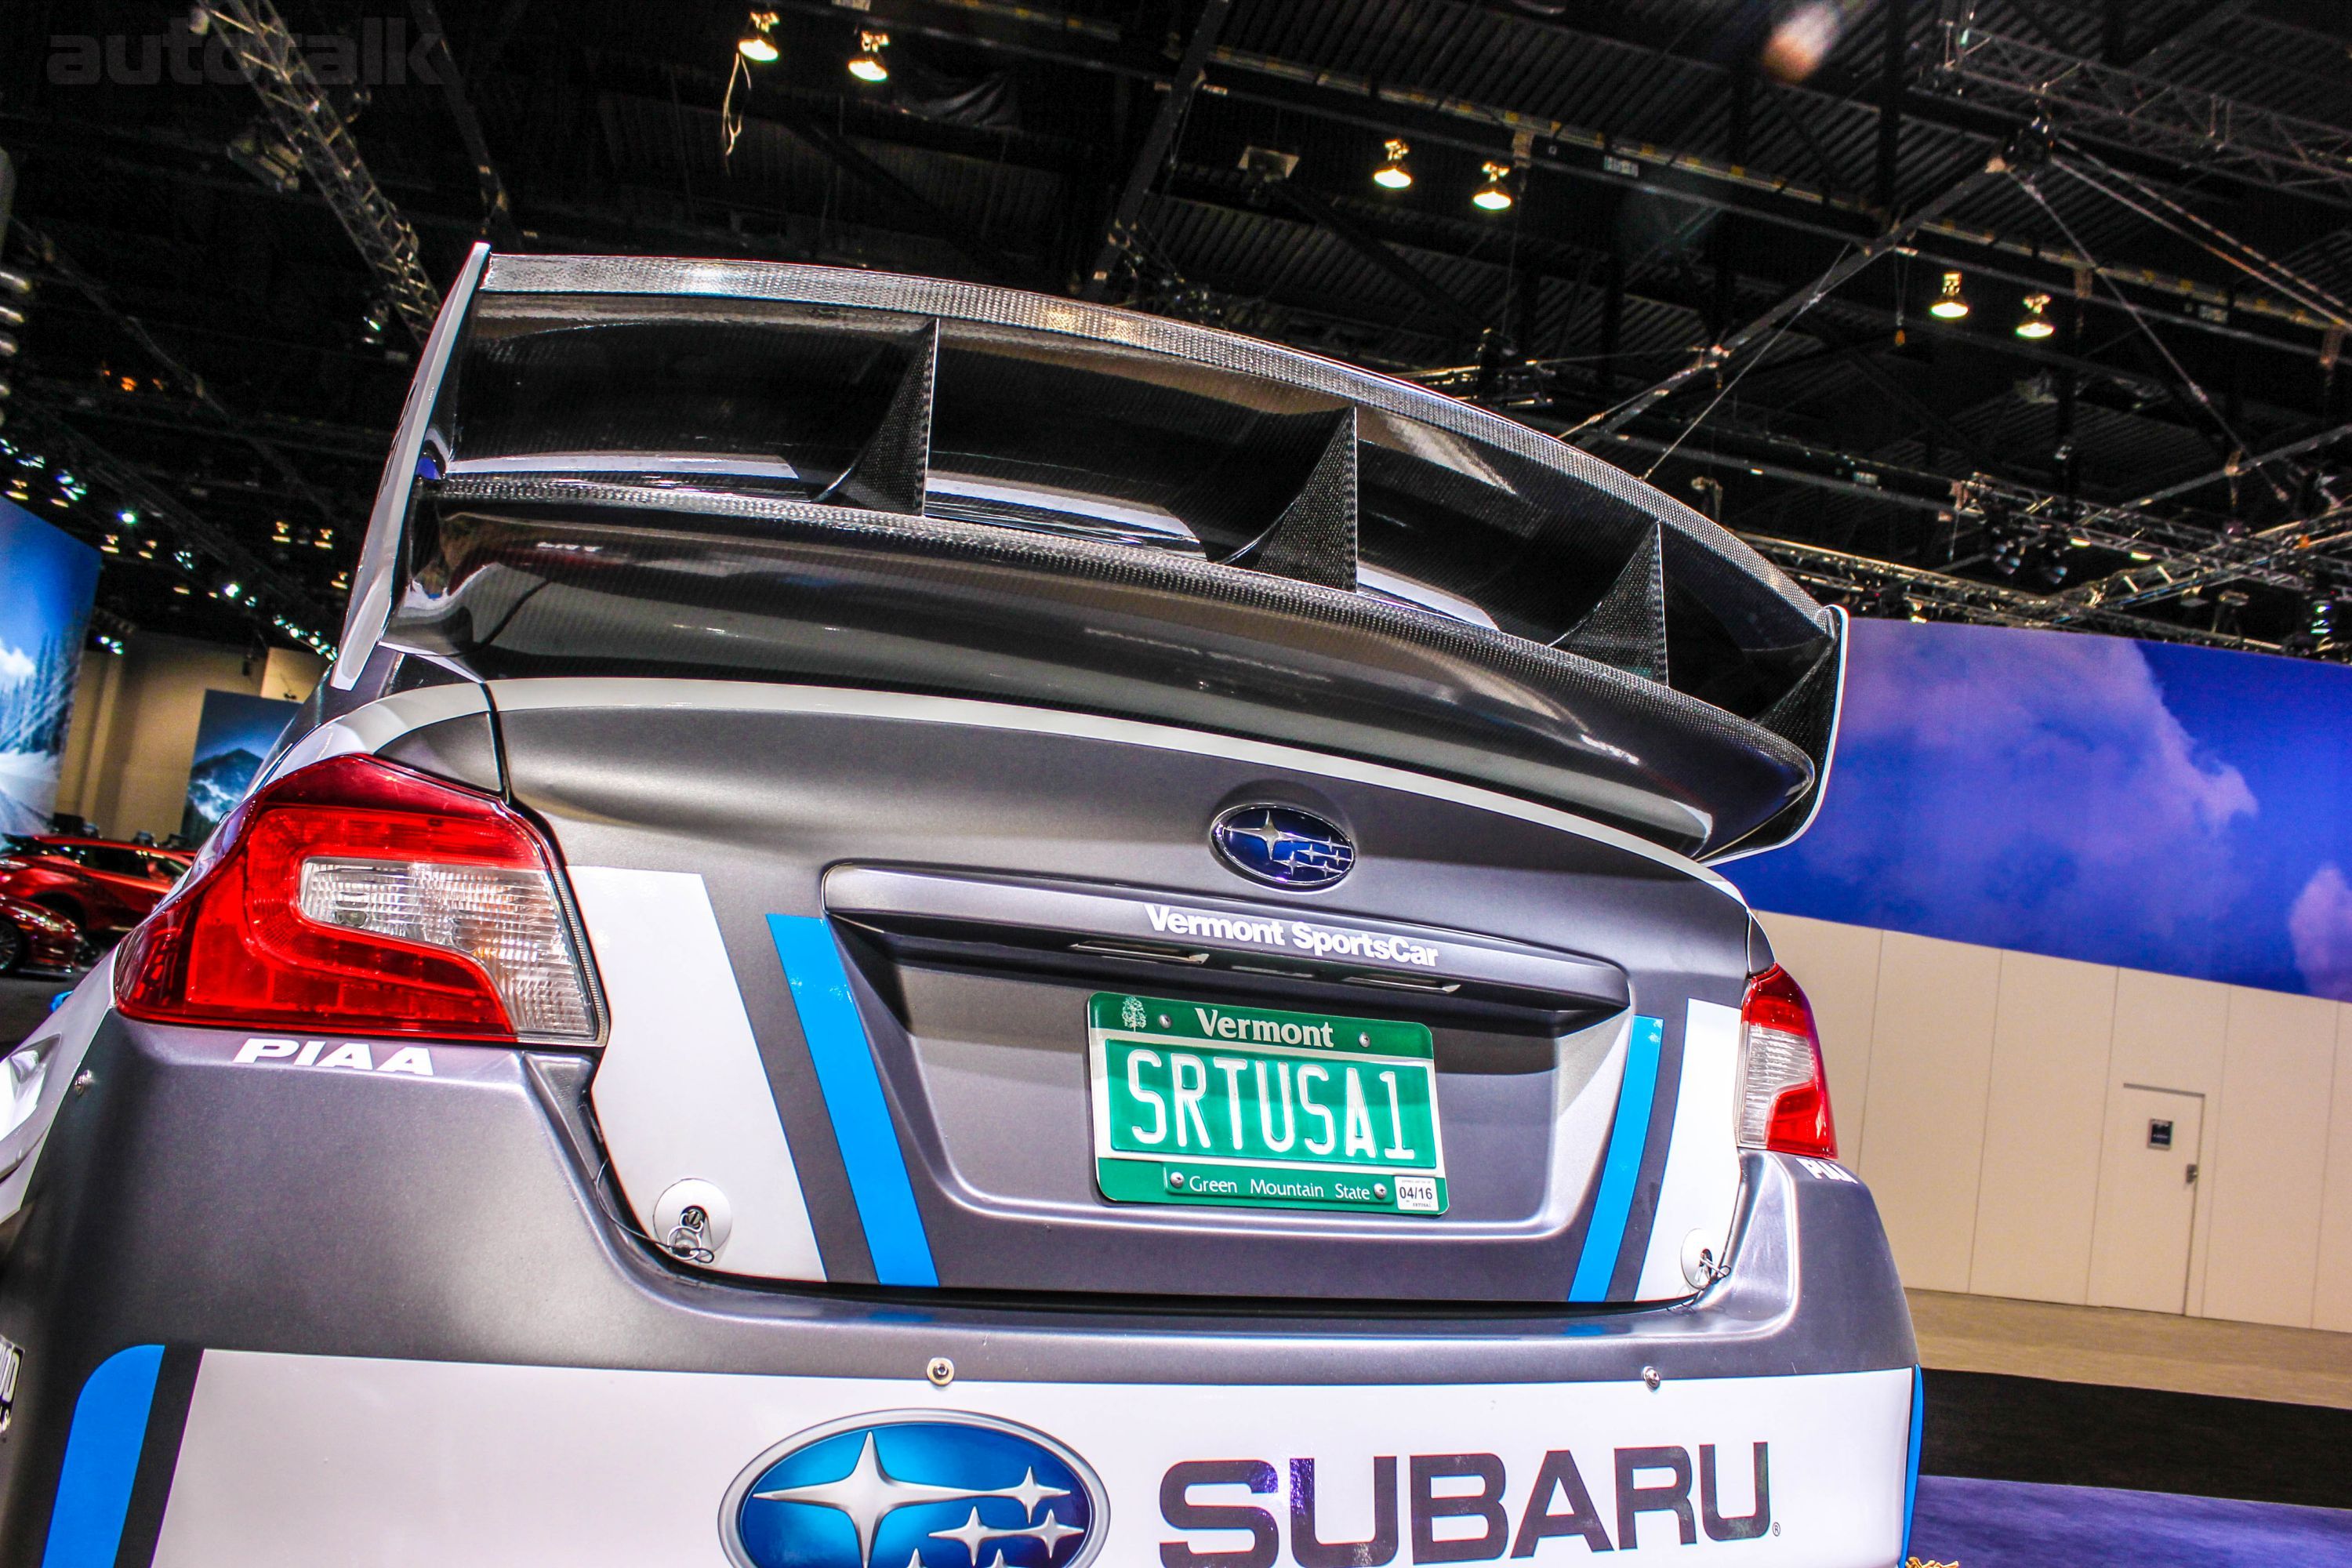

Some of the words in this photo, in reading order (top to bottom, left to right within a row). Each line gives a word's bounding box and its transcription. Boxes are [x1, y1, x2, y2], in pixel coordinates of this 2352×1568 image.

[1145, 904, 1286, 946] Vermont
[1291, 920, 1439, 967] SportsCar
[1194, 1007, 1334, 1047] Vermont
[232, 1038, 434, 1076] PIAA
[1127, 1049, 1415, 1160] SRTUSA1
[1189, 1176, 1238, 1194] Green
[1250, 1179, 1325, 1199] Mountain
[1334, 1183, 1371, 1201] State
[1399, 1186, 1433, 1200] 04/16
[1159, 1441, 1771, 1568] SUBARU
